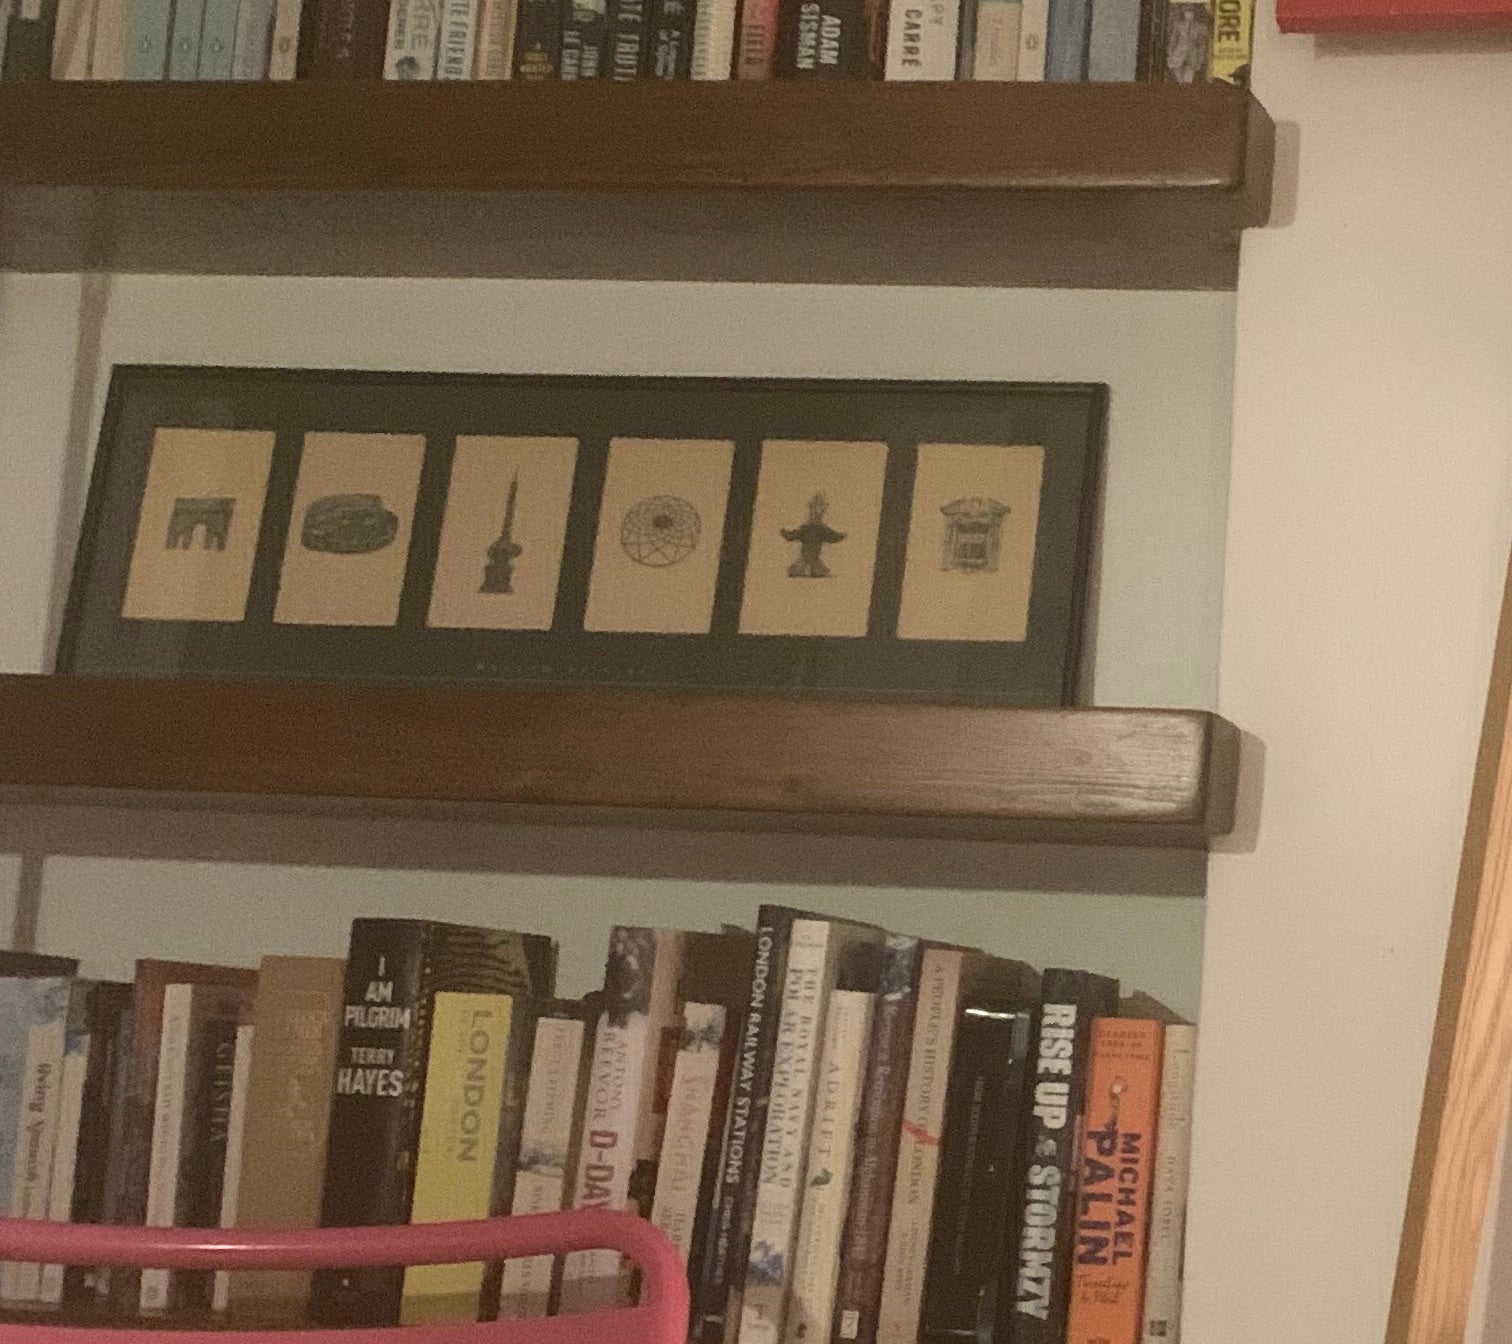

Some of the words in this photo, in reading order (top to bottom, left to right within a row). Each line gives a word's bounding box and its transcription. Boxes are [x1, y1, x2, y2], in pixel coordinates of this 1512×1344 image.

[444, 21, 469, 80] FRIEND
[795, 1, 821, 70] SISMAN
[818, 13, 842, 66] ADAM
[364, 981, 394, 1003] AM
[378, 955, 386, 977] I
[748, 926, 775, 1009] LONDON
[780, 967, 805, 1028] POLAR
[800, 967, 819, 1005] THE
[344, 1005, 412, 1030] PILGRIM
[791, 1014, 815, 1079] ROYAL
[1037, 1003, 1078, 1075] RISE
[336, 1068, 405, 1098] HAYES
[351, 1047, 396, 1065] TERRY
[592, 1031, 616, 1121] BEEVOR
[611, 1039, 629, 1112] ANTONY
[737, 1011, 763, 1092] RAILWAY
[916, 1047, 939, 1114] HISTORY
[457, 1009, 494, 1164] LONDON
[760, 1029, 798, 1186] EXPLORATION
[784, 1088, 806, 1140] NAVY
[816, 1060, 841, 1159] ADRIFT
[1030, 1080, 1071, 1130] UP
[725, 1095, 750, 1185] STATIONS
[777, 1149, 798, 1190] AND
[905, 1142, 926, 1206] LONDON
[1075, 1129, 1119, 1267] PALIN
[1111, 1132, 1142, 1266] MICHAEL
[1016, 1163, 1062, 1321] STORMZY
